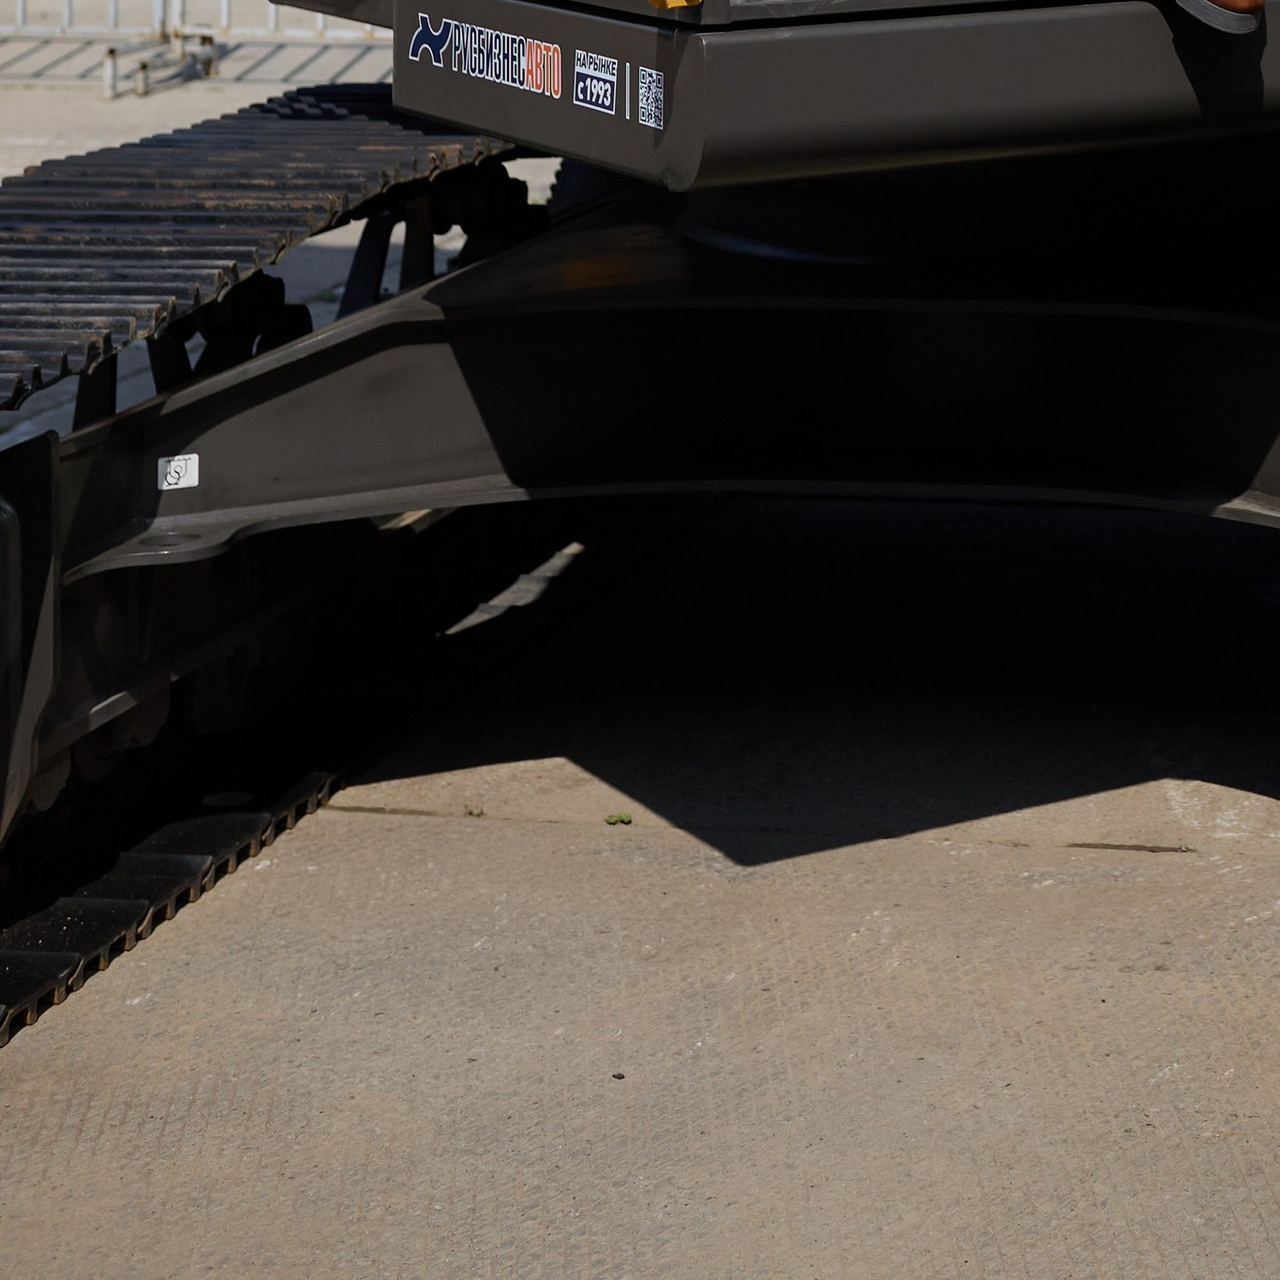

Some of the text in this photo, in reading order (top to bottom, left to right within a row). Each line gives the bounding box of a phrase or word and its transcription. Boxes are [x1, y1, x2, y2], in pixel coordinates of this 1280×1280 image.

[451, 20, 562, 100] РУСБИЗНЕСАВТО
[576, 51, 617, 77] НА РЫНКЕ
[585, 77, 612, 107] 1993
